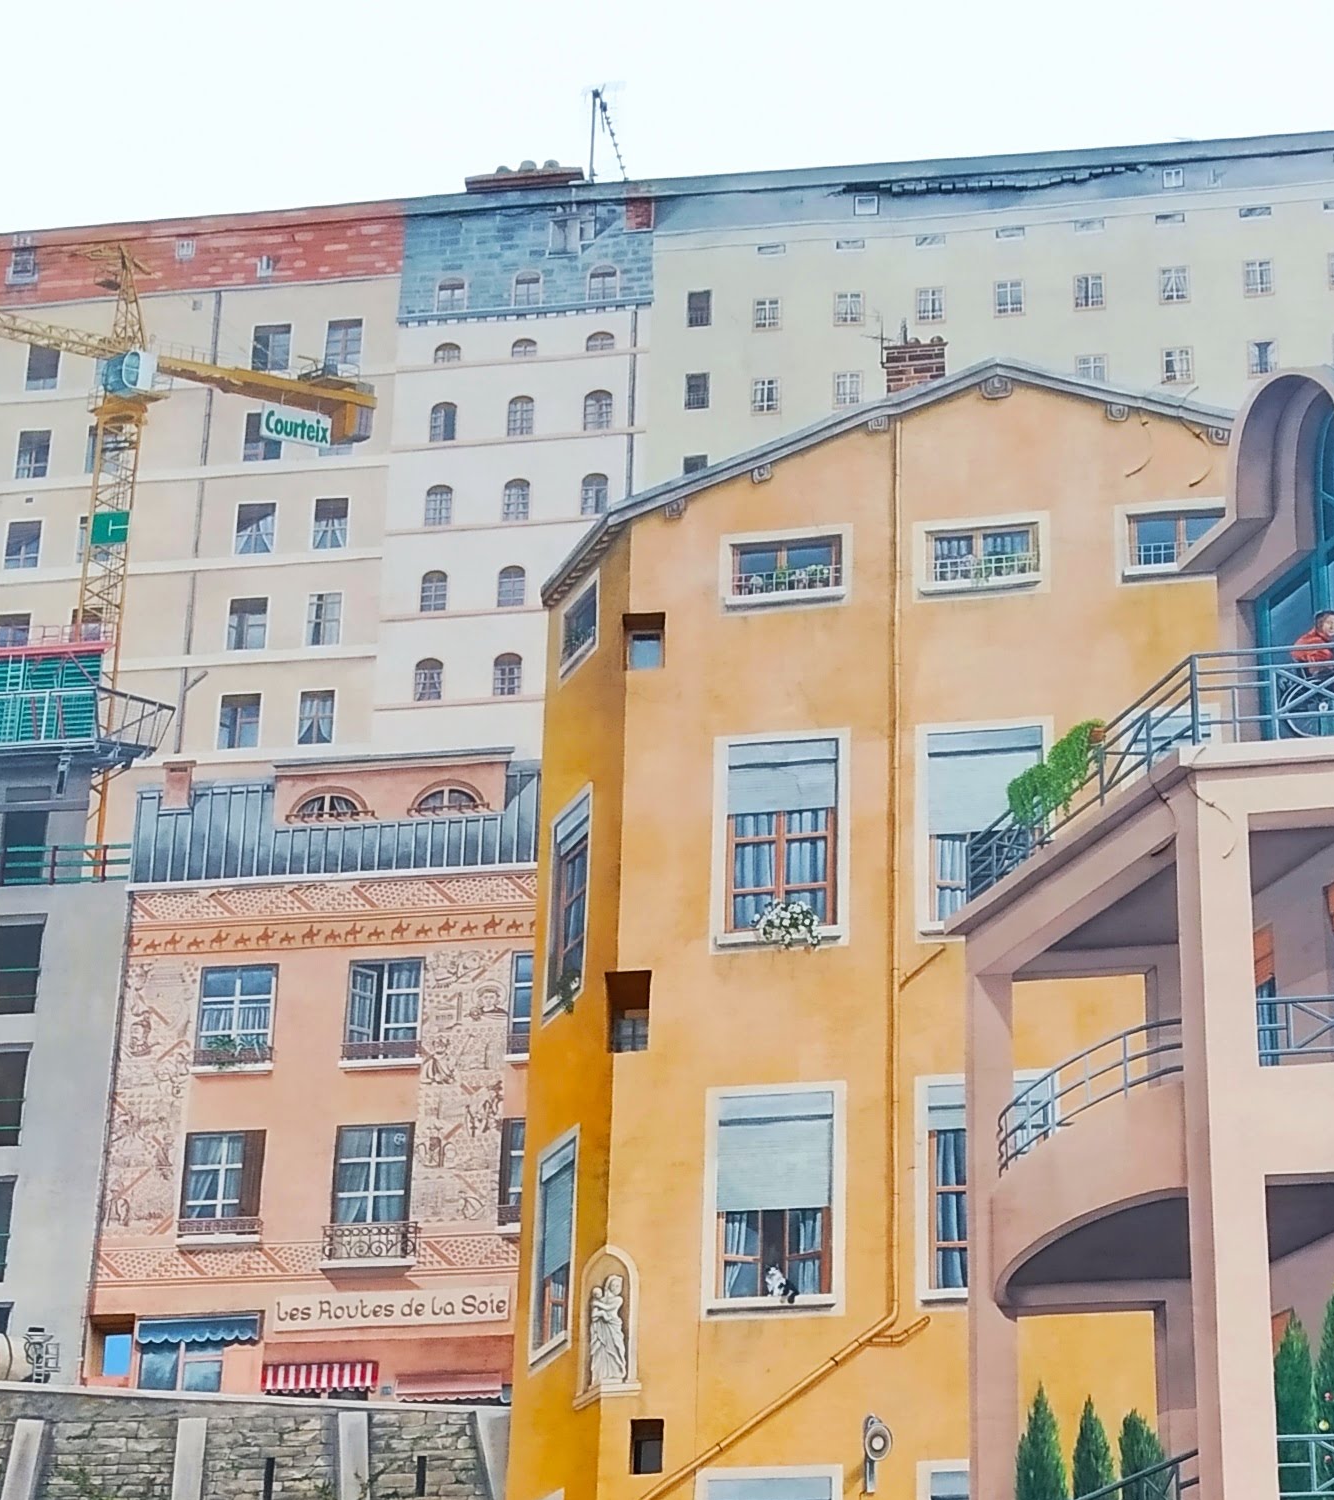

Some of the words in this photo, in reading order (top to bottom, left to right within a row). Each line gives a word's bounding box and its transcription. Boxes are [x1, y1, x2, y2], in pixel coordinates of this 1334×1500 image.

[265, 410, 329, 444] Courteix
[318, 1299, 395, 1320] Routes
[400, 1298, 426, 1317] de
[461, 1293, 507, 1315] Soie
